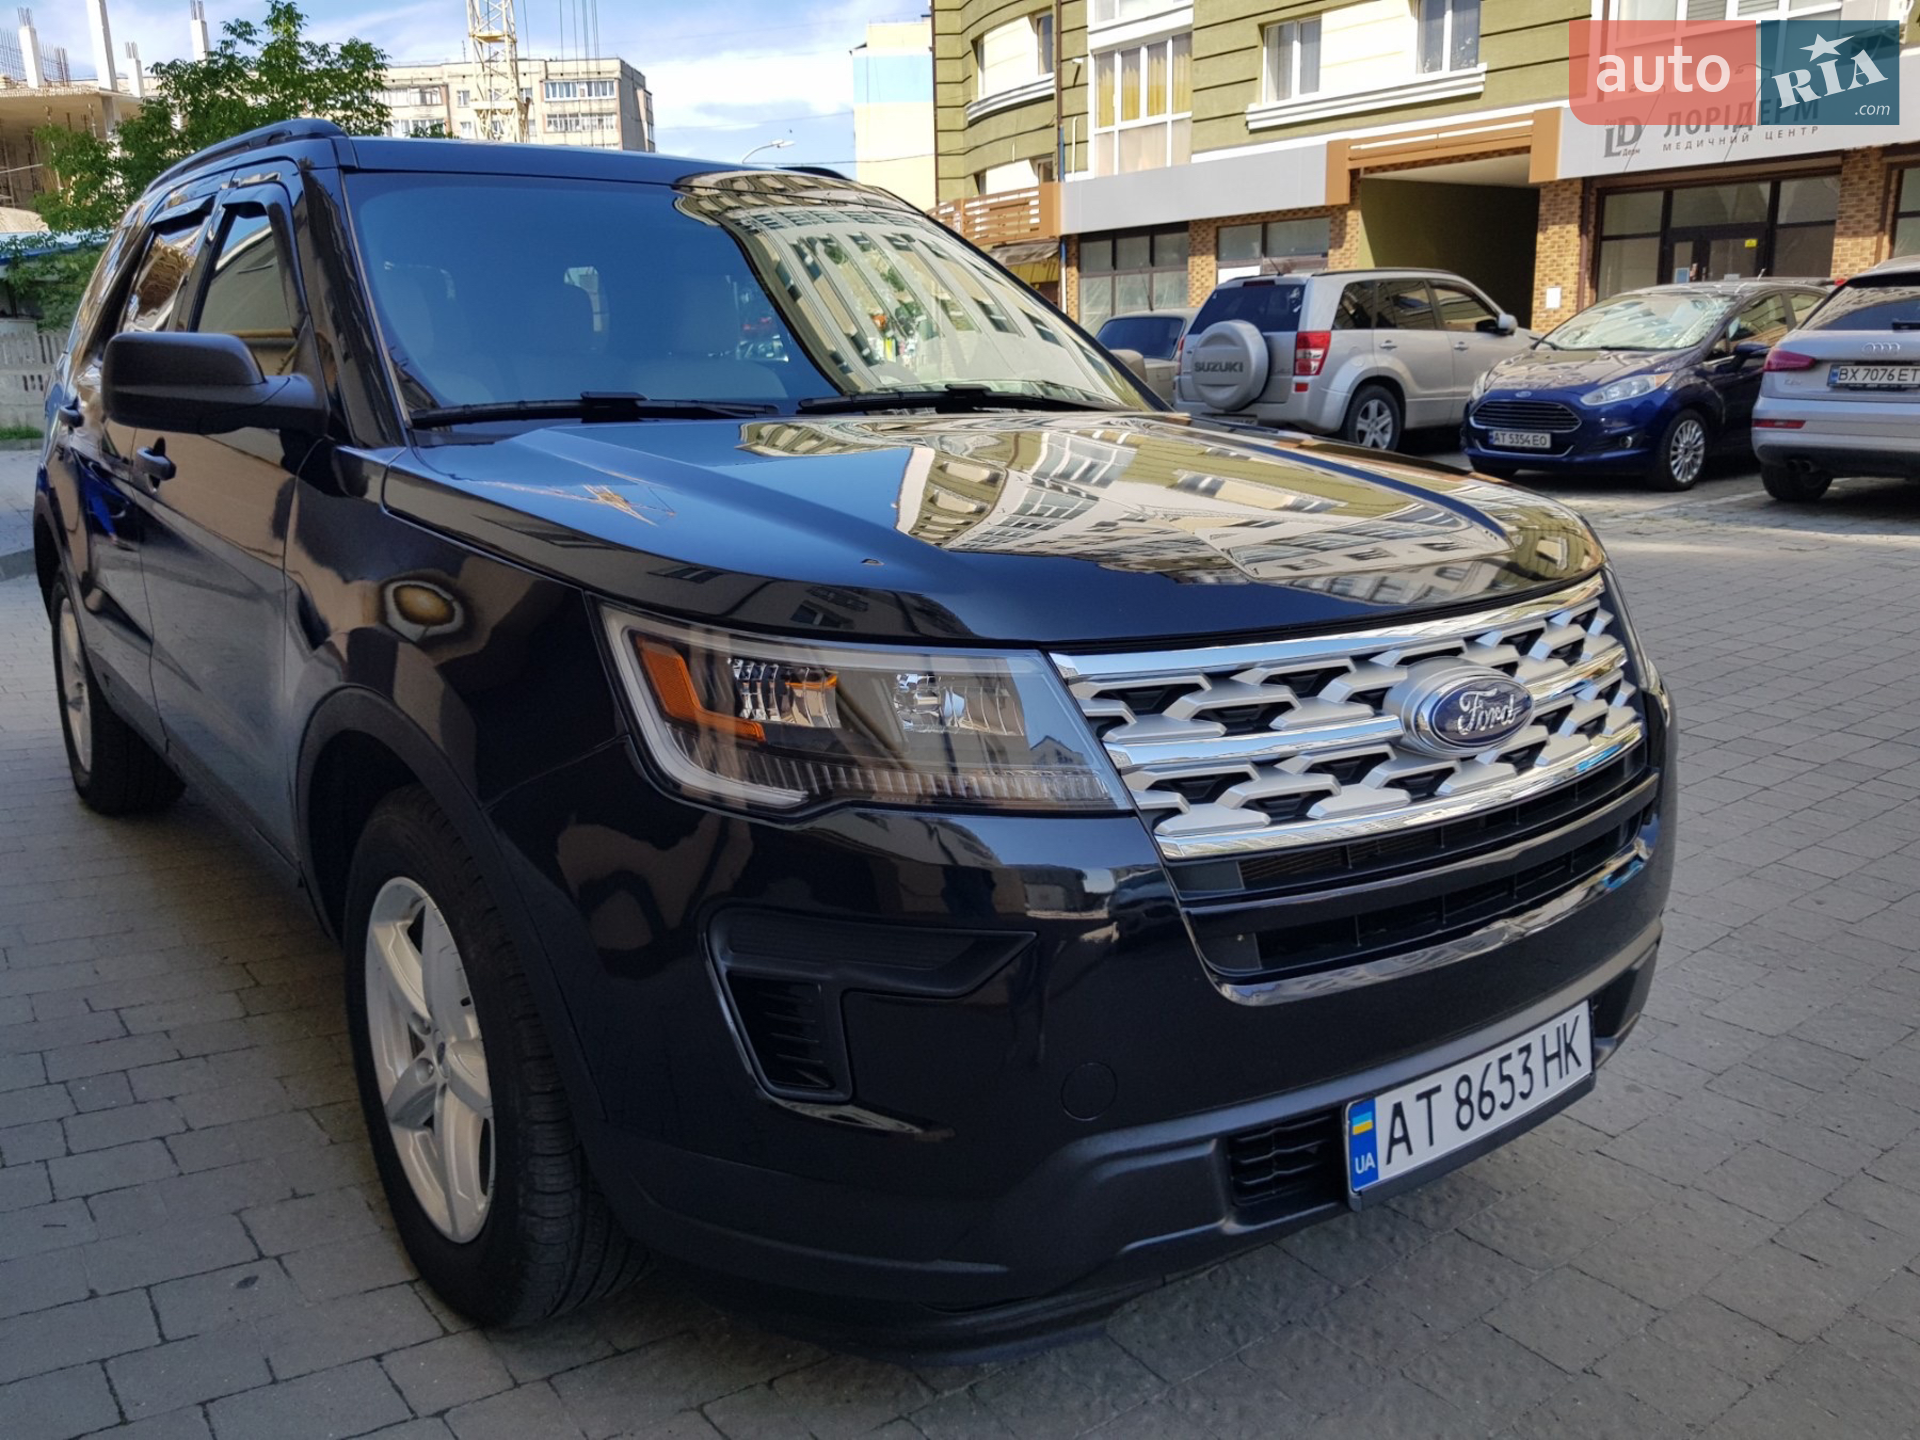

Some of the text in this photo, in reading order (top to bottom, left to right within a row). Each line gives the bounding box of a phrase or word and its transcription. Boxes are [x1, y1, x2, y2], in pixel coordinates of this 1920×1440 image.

[1662, 125, 1819, 152] МЕДИЧНИЙ ЦЕНТР
[1194, 361, 1244, 373] SUZUKI
[1838, 368, 1860, 381] BX
[1862, 368, 1895, 381] 7076
[1457, 688, 1521, 735] Ford
[1386, 1014, 1582, 1165] AT 8653 HK
[1354, 1152, 1376, 1174] UA
